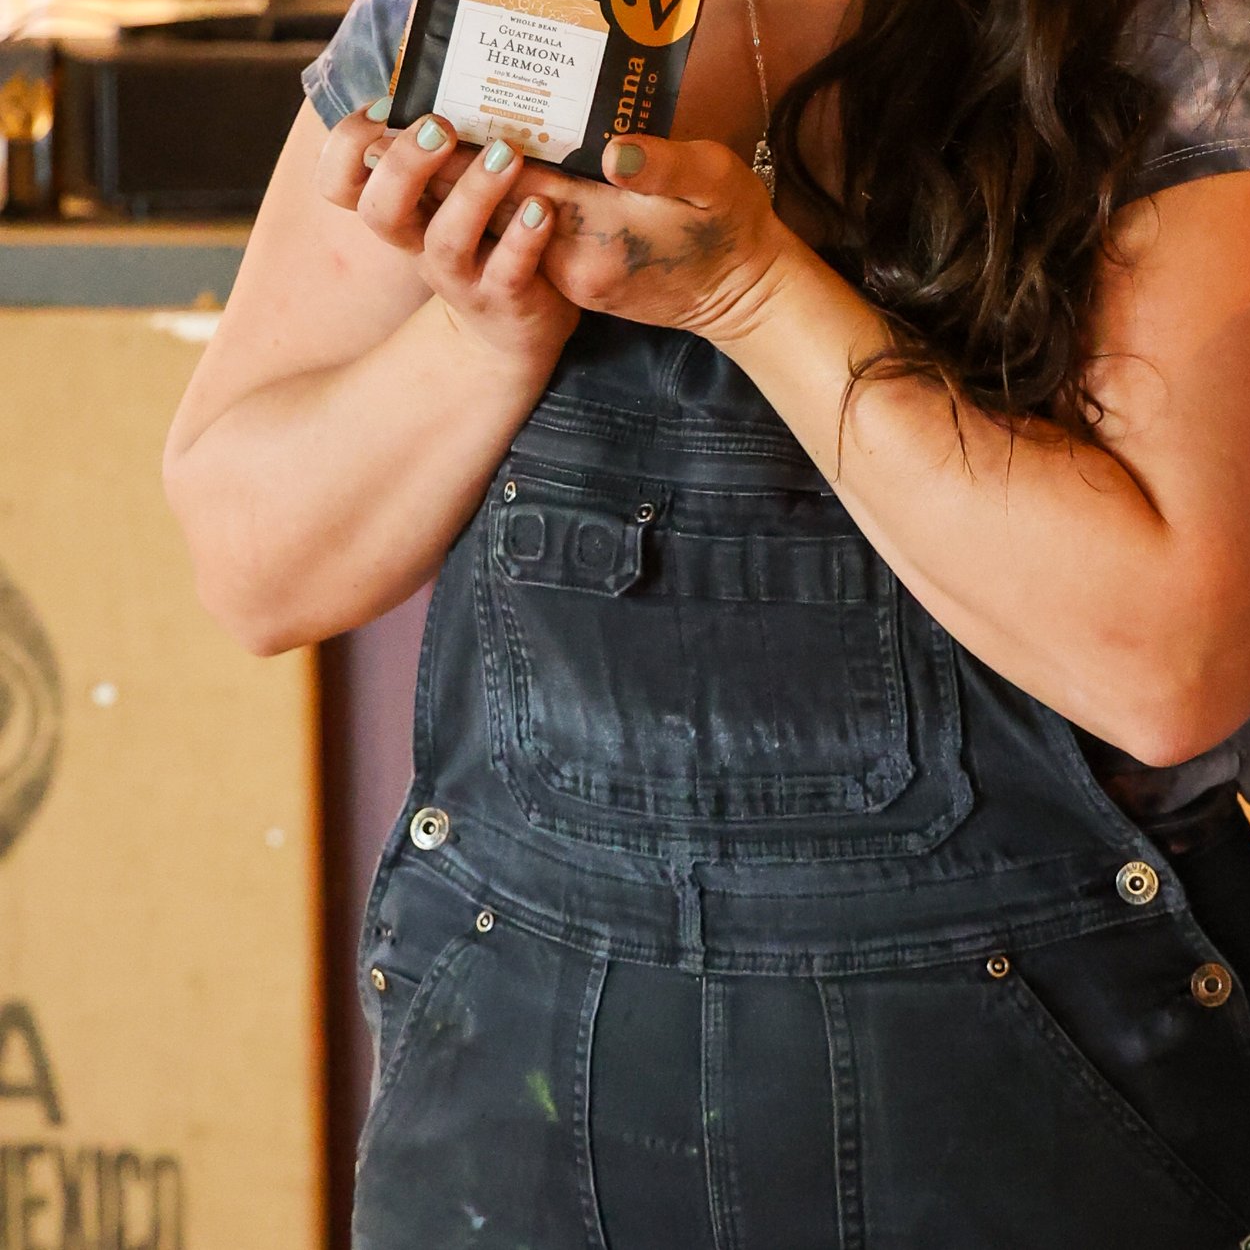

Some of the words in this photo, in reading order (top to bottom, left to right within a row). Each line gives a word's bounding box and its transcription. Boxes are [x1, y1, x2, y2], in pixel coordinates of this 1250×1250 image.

[499, 24, 562, 48] GUATEMALA
[510, 16, 536, 27] WHOLE
[538, 23, 558, 32] BEAN
[479, 32, 498, 48] LA
[503, 39, 575, 66] ARMONIA
[487, 50, 560, 78] HERMOSA
[481, 85, 514, 97] TOASTED
[516, 94, 549, 107] ALMOND,
[513, 102, 544, 114] VANILLA
[604, 56, 645, 139] enna
